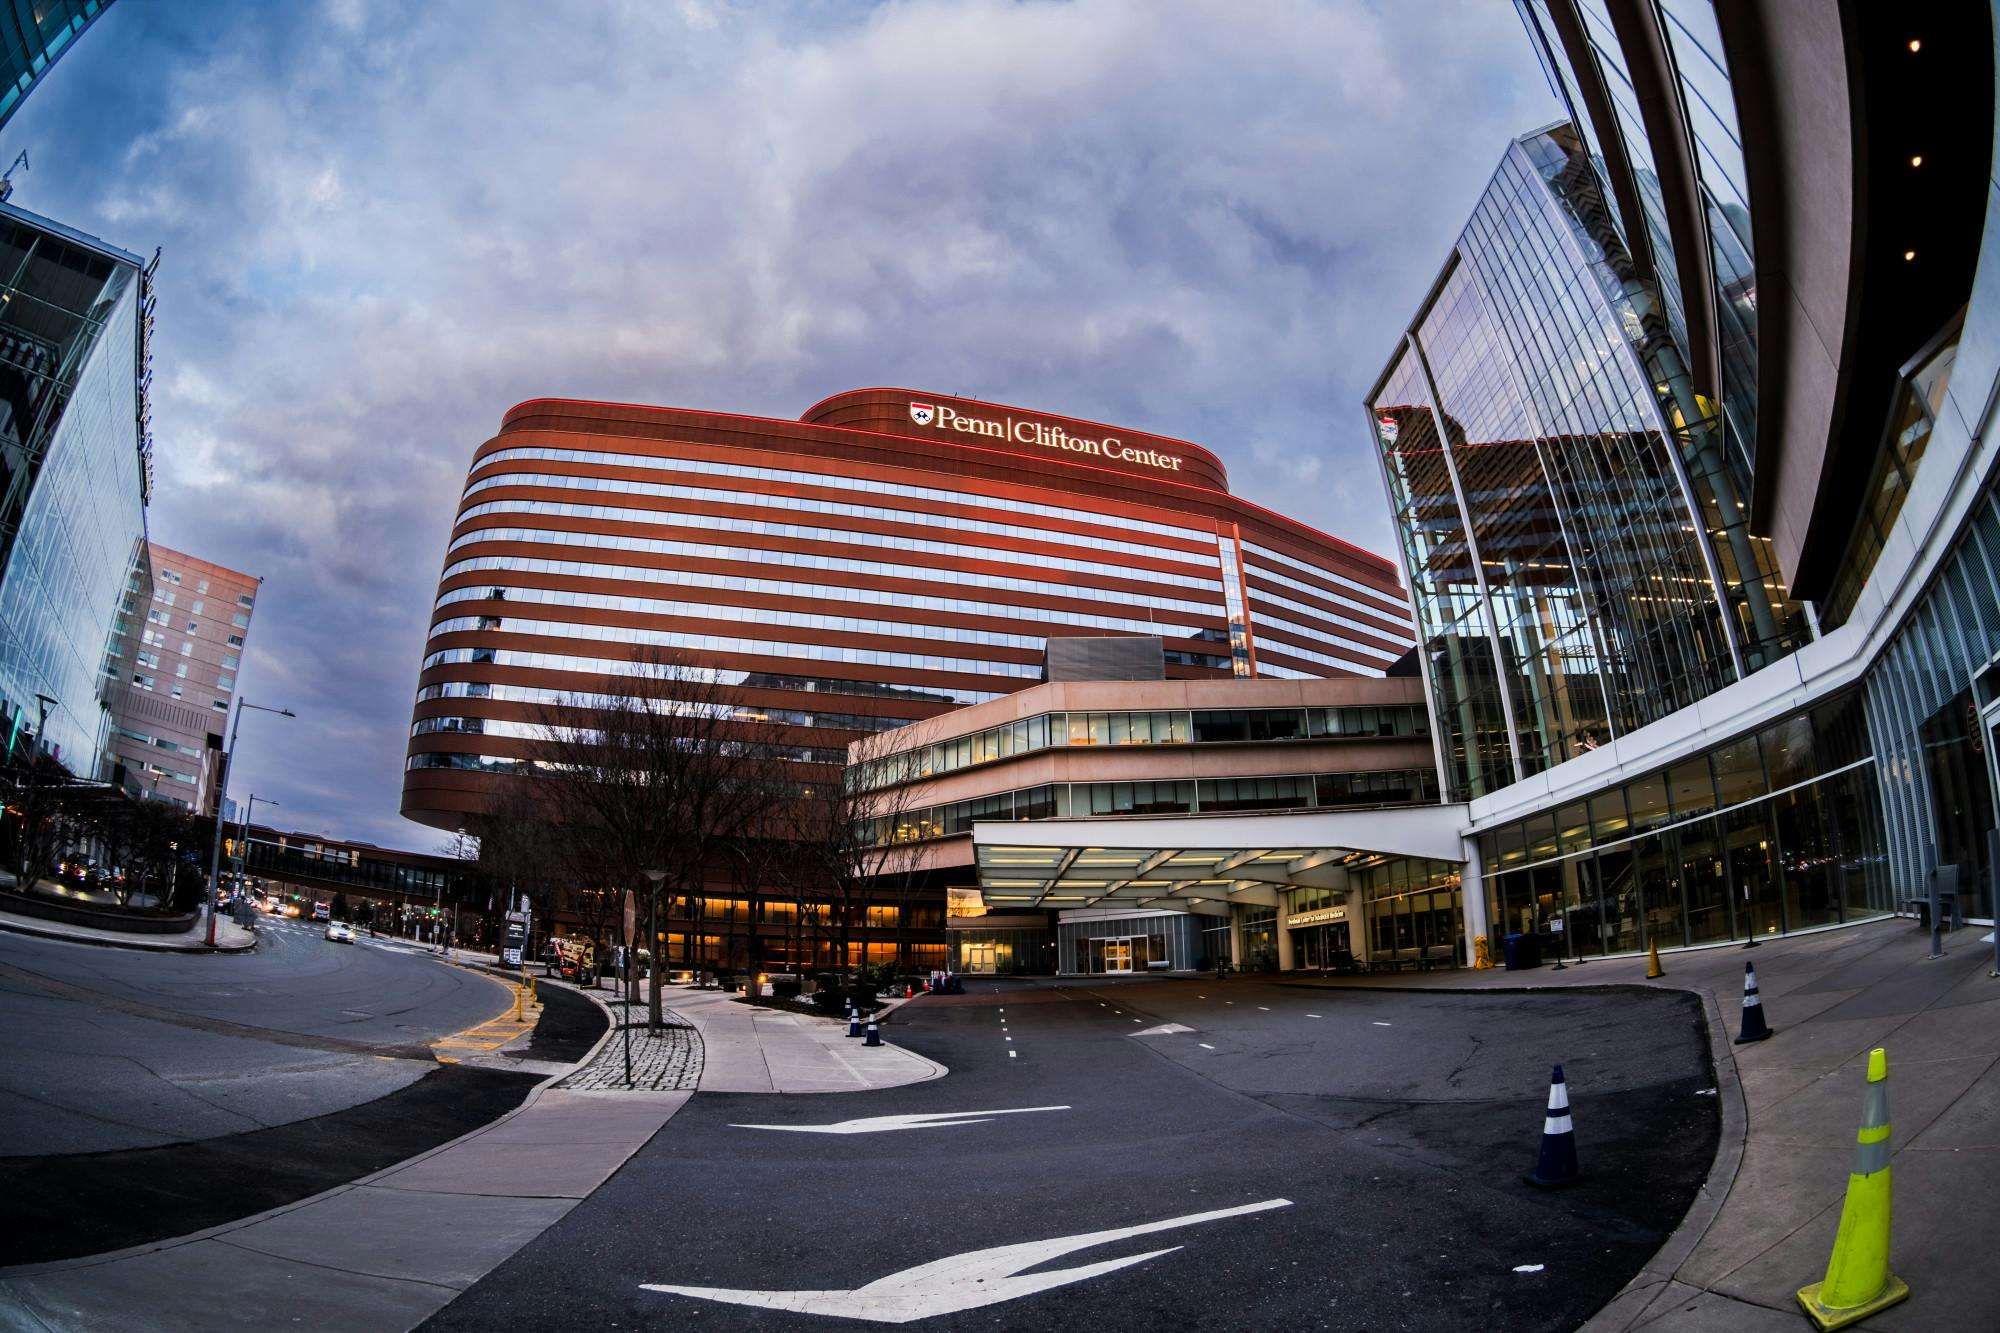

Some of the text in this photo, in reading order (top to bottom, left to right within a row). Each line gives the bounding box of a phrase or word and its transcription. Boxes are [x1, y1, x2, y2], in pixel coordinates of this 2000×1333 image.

[936, 406, 1183, 471] Penn Clifton Center
